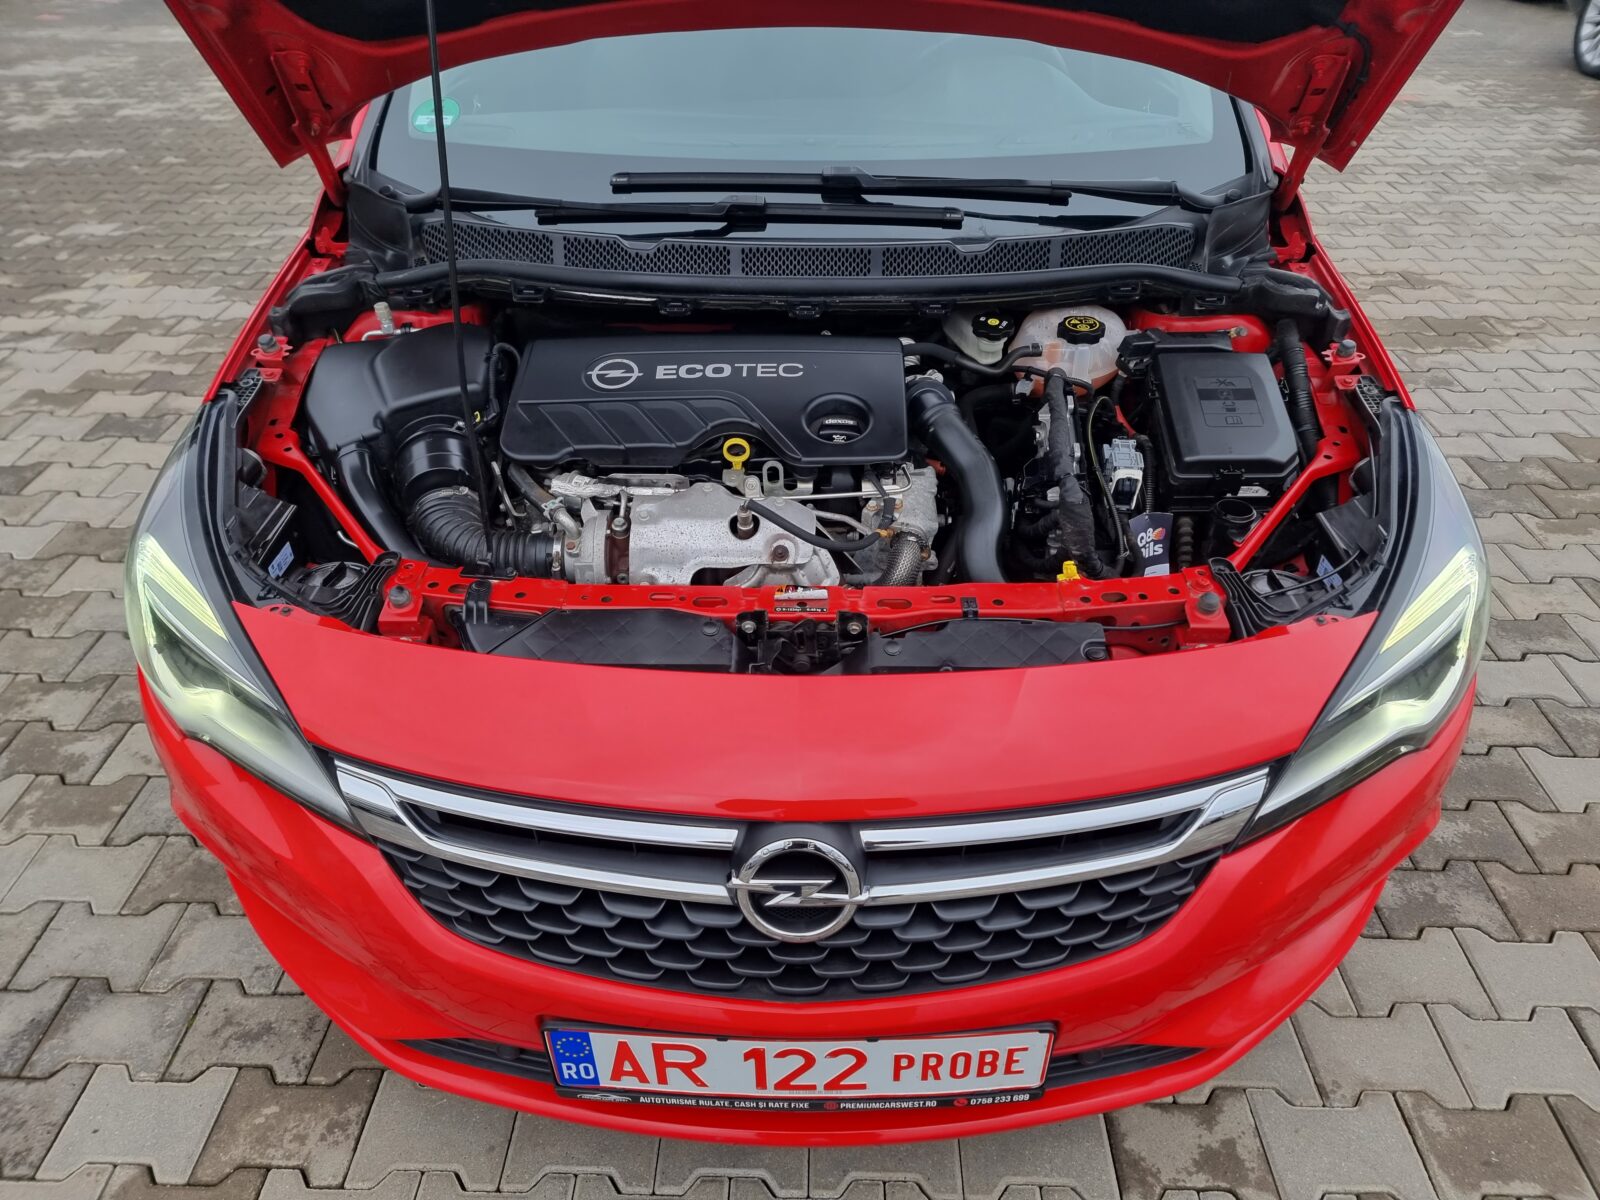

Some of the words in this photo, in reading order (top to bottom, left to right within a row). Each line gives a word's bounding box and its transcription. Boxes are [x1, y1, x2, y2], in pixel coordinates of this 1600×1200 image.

[655, 363, 804, 379] ECOTEC
[561, 1062, 595, 1080] RO
[610, 1041, 709, 1087] AR
[743, 1048, 868, 1091] 122
[892, 1047, 1029, 1082] PROBE
[639, 1096, 697, 1105] AUTOTURISME
[840, 1101, 937, 1109] PREMIUMCARSWEST.RO
[994, 1096, 1012, 1104] 233
[1012, 1093, 1030, 1102] 699
